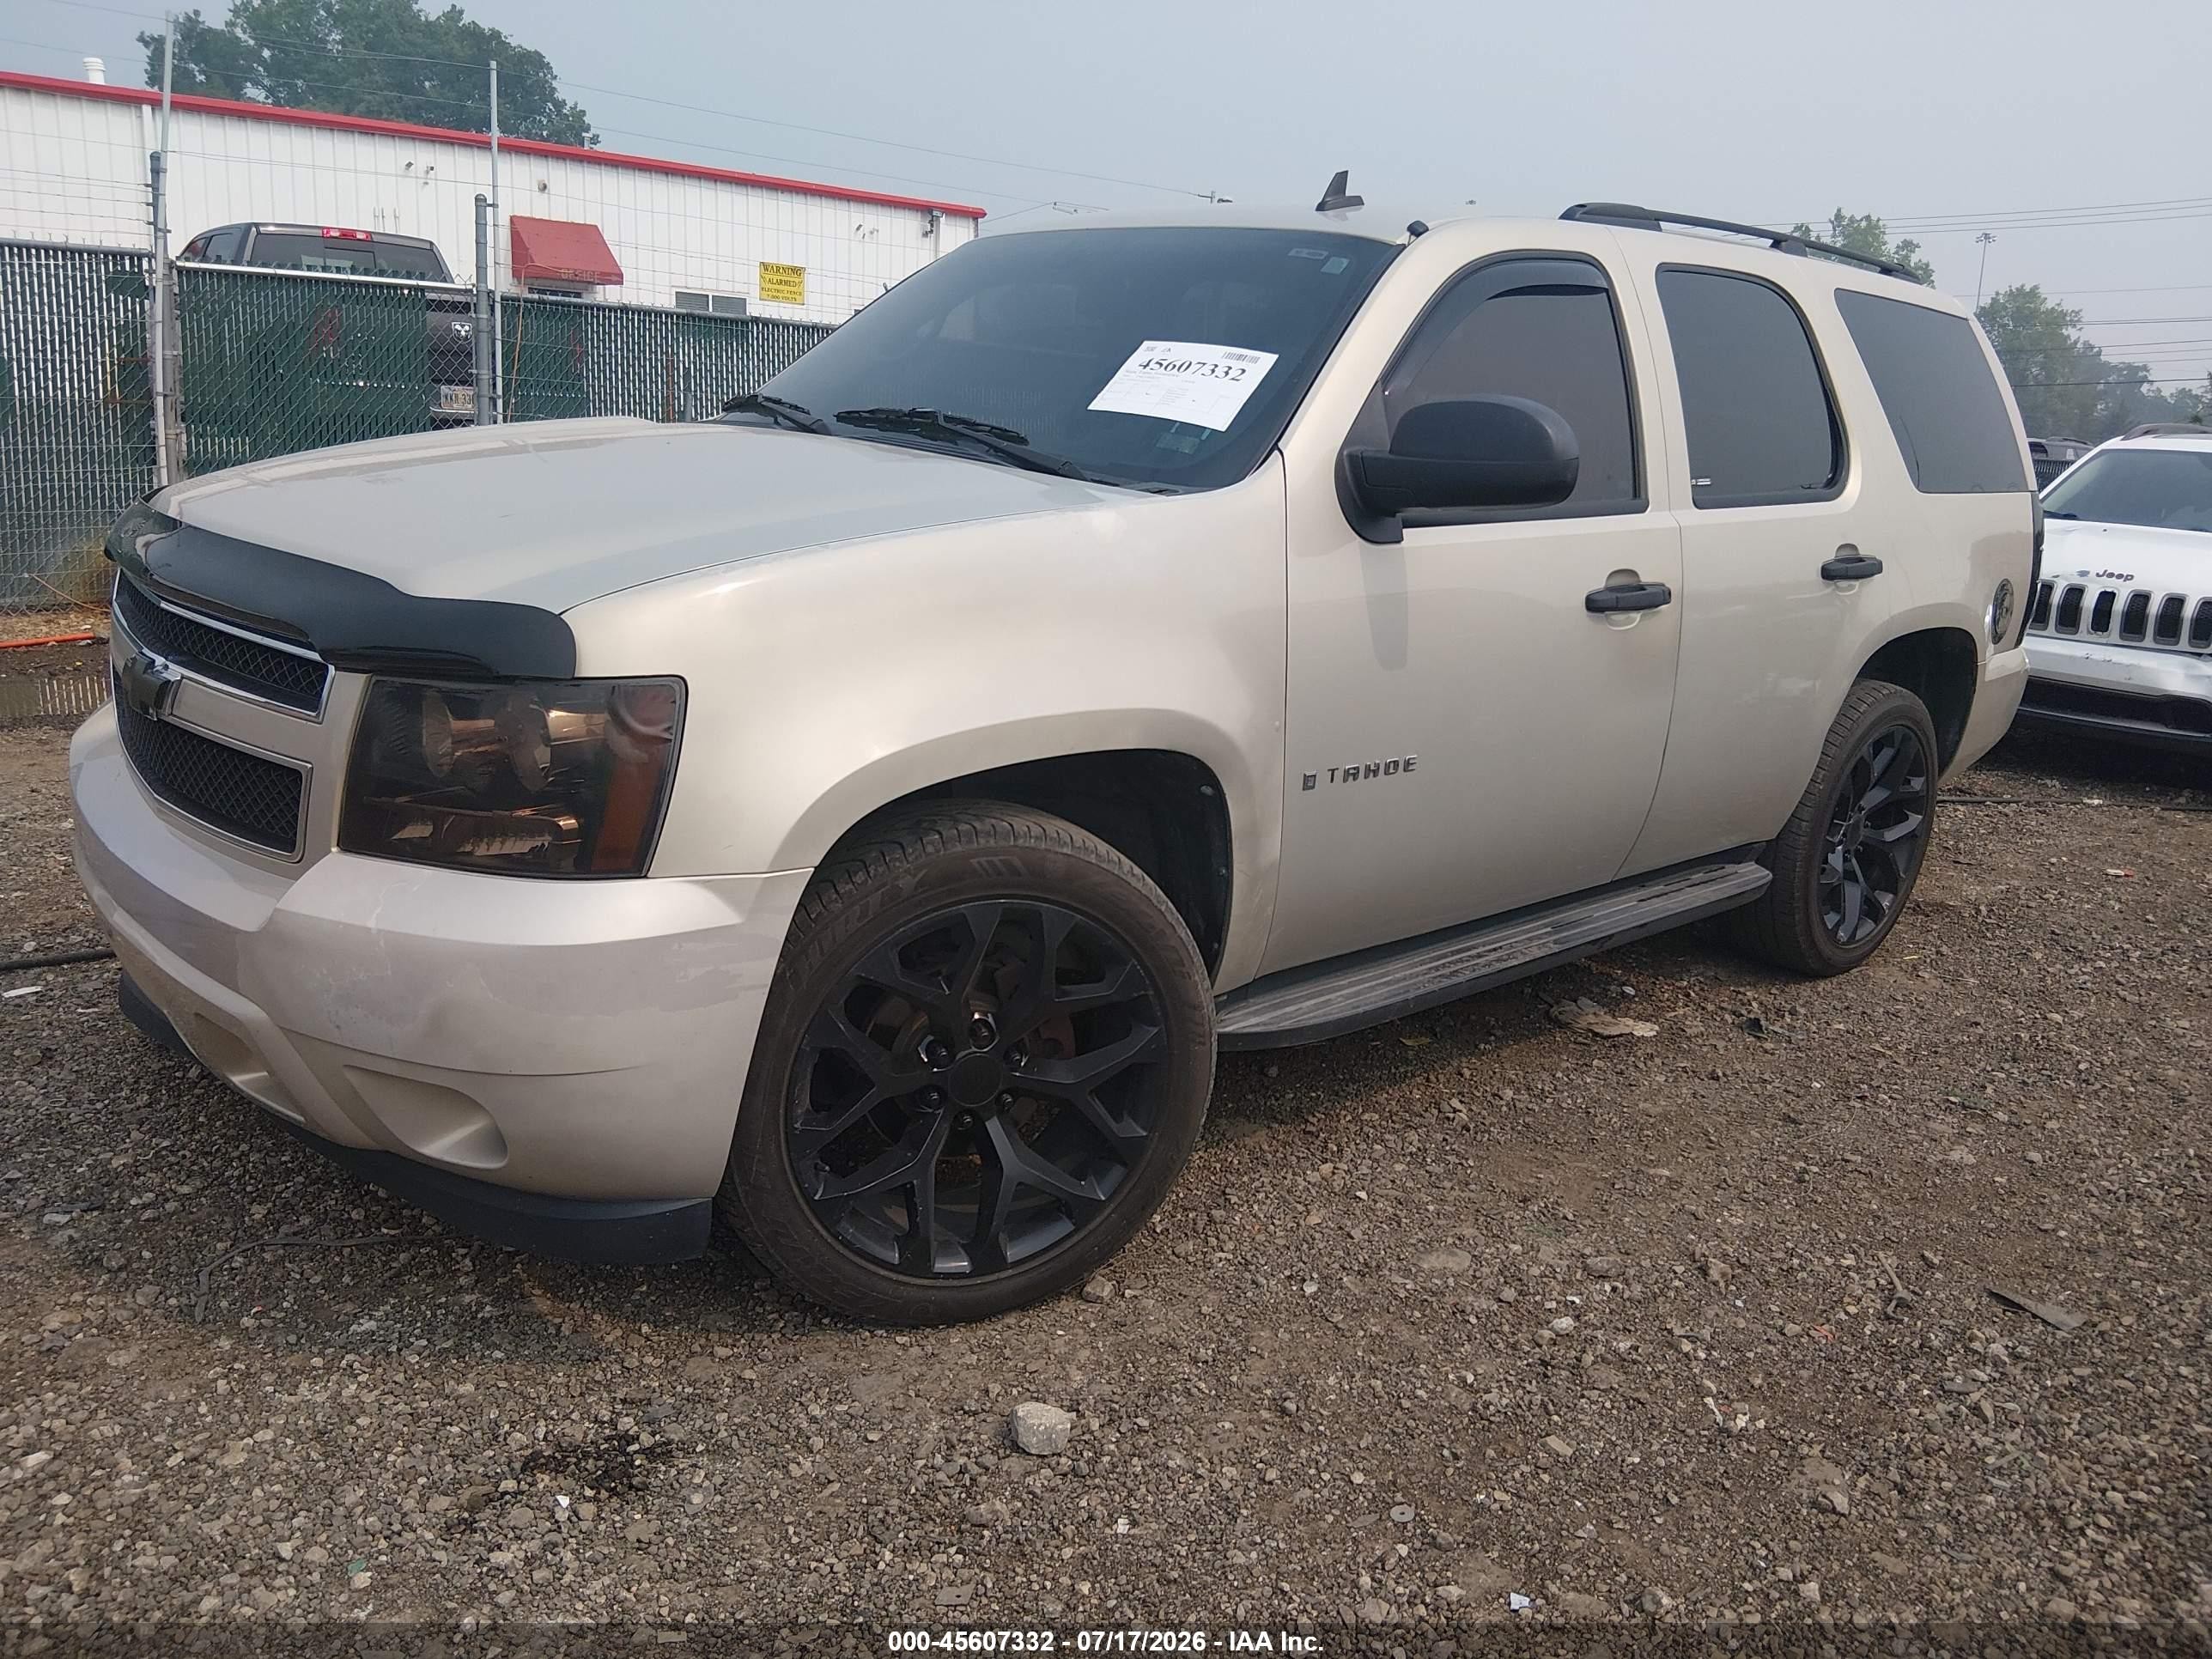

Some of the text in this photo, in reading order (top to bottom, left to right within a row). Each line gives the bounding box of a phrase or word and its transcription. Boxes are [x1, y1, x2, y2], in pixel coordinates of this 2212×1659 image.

[763, 264, 802, 276] WARNING
[768, 277, 797, 288] ALARMED
[1138, 357, 1248, 382] 45607332
[2095, 569, 2135, 582] Jeep
[1327, 755, 1418, 784] TAHOE
